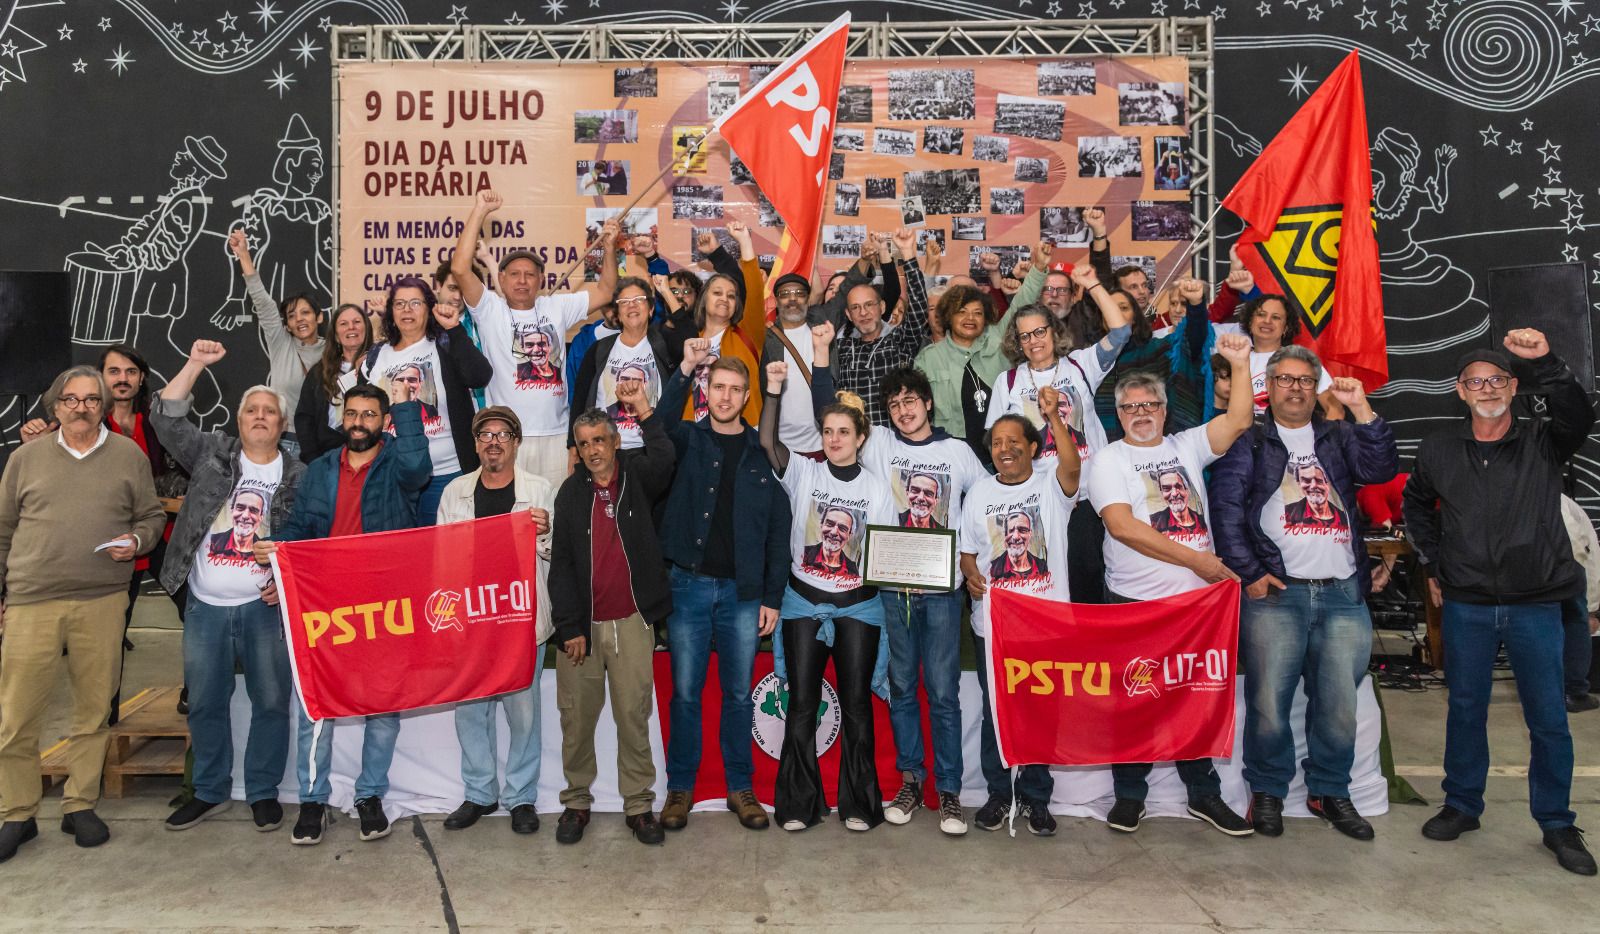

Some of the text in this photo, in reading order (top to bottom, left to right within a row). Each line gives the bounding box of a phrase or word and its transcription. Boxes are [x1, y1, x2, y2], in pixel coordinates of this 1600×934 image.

[365, 89, 544, 128] 9 DE JULHO
[765, 61, 830, 188] PS
[364, 140, 528, 166] DIA DA LUTA
[364, 164, 492, 197] OPERÁRIA
[364, 216, 525, 239] EM MEMÓR DAS
[364, 247, 415, 265] LUTAS
[422, 247, 431, 265] E
[555, 246, 578, 264] DA
[364, 273, 423, 291] CLA
[301, 597, 415, 648] PSTU
[464, 579, 531, 618] LIT-QI
[1003, 658, 1111, 697] PSTU
[1163, 648, 1228, 685] LIT-QI
[752, 686, 763, 701] DOS
[761, 674, 775, 687] TRA
[824, 723, 839, 745] TERRA
